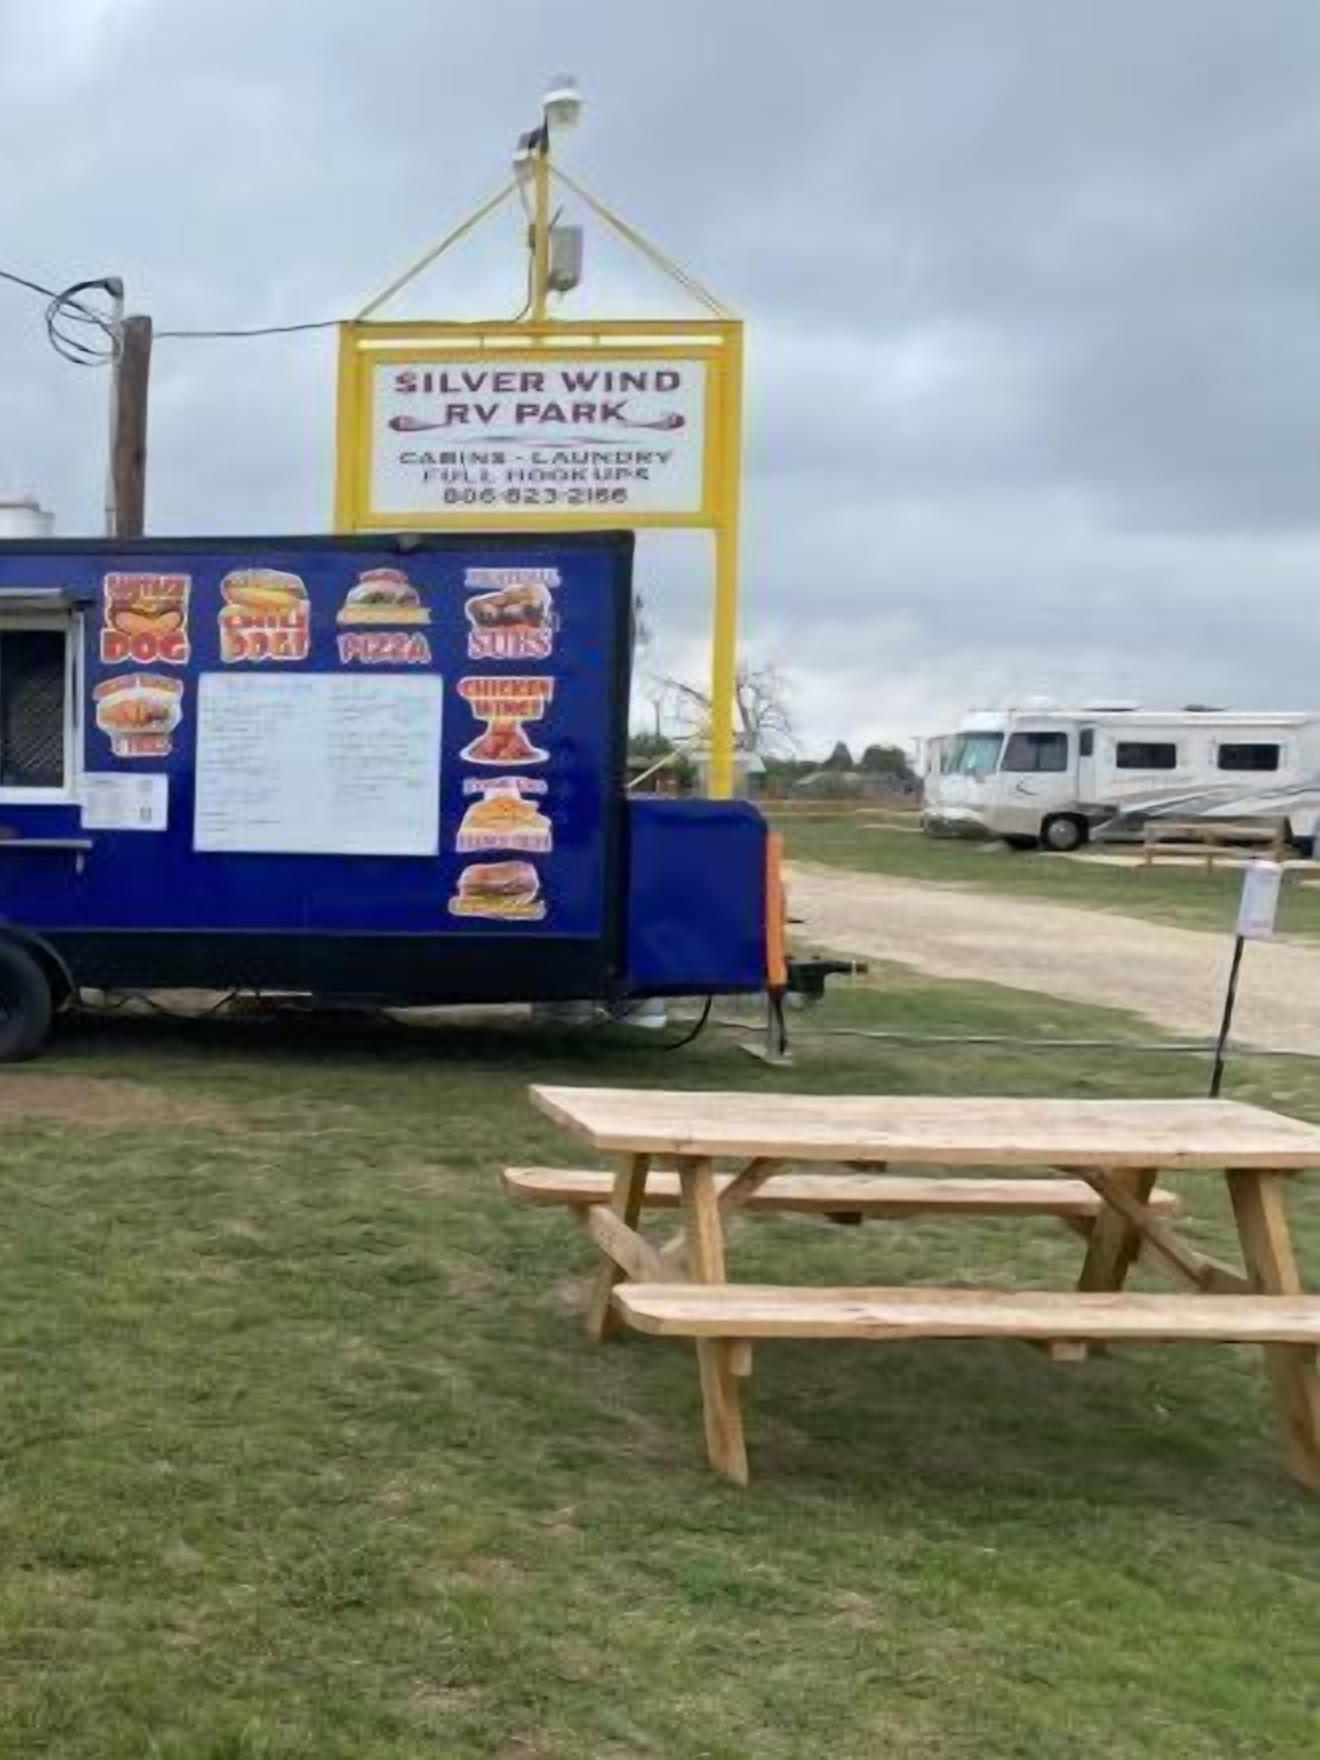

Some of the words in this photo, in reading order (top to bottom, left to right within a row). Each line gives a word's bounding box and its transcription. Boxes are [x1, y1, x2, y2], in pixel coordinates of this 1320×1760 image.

[395, 371, 545, 393] SILVER
[561, 371, 681, 393] WIND
[445, 402, 500, 425] RV
[515, 401, 629, 425] PARK
[399, 451, 507, 465] CABINS
[531, 450, 674, 465] LAUNDRY
[422, 467, 493, 484] FULL
[103, 631, 188, 662] DOG
[339, 634, 430, 662] PIZZA
[470, 629, 551, 657] SUBS
